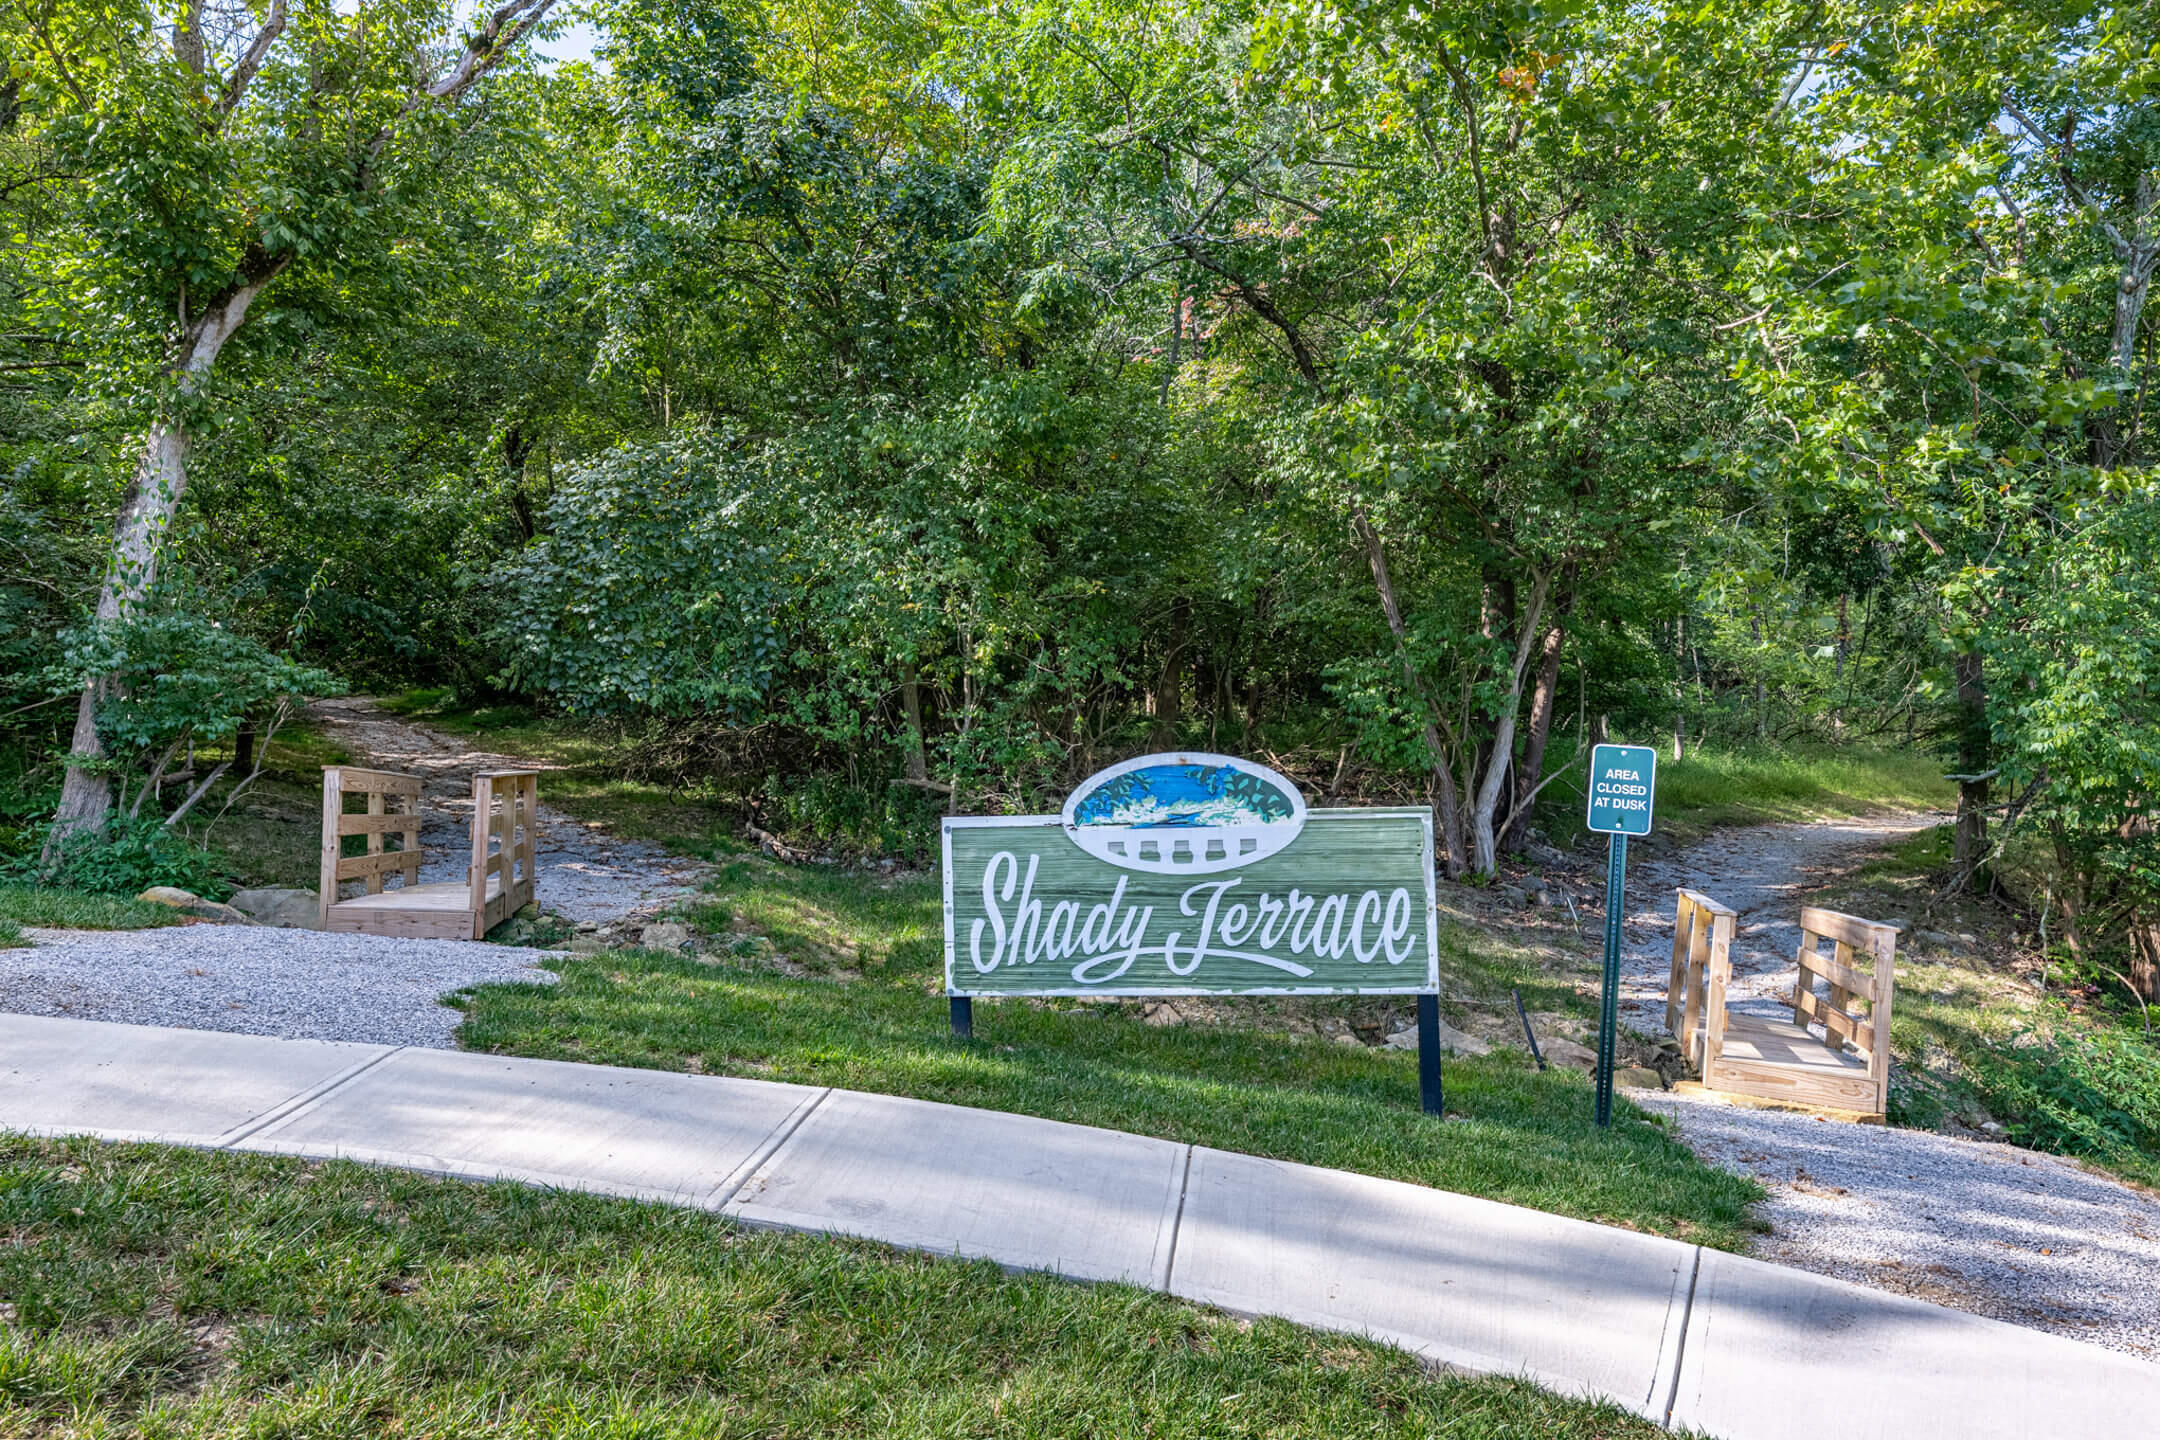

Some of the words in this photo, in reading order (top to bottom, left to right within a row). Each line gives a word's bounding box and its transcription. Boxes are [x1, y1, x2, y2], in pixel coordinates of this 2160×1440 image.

[1605, 768, 1640, 781] AREA
[1597, 782, 1647, 796] CLOSED
[1594, 797, 1610, 808] AT
[1612, 798, 1647, 811] DUSK
[970, 851, 1154, 984] Shady
[1165, 876, 1417, 977] Terrace
